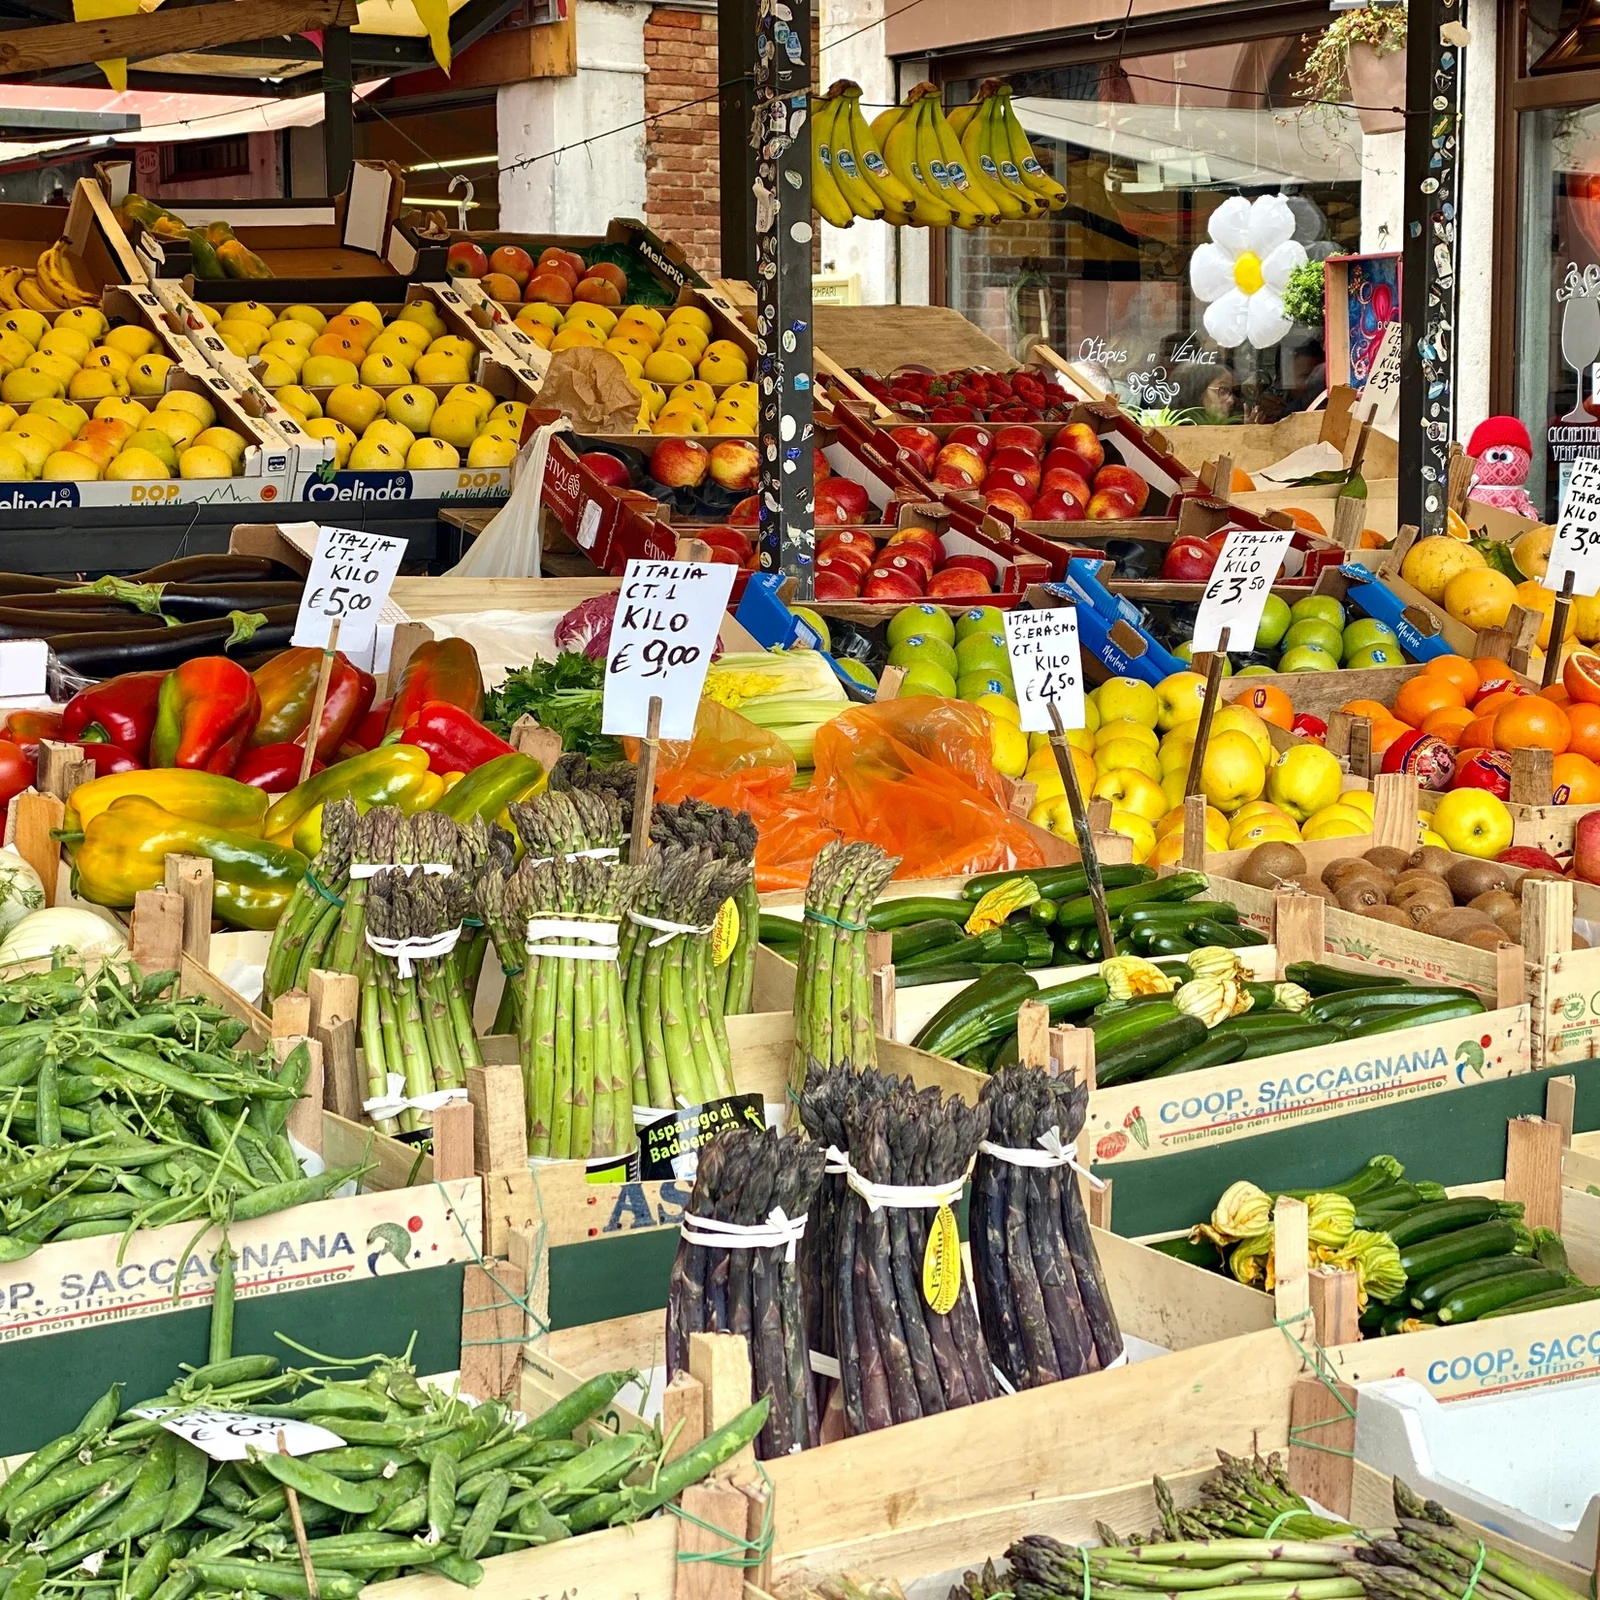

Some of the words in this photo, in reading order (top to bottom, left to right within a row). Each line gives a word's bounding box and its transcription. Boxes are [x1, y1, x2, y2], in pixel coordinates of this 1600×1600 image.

[1564, 504, 1597, 522] KILO
[330, 564, 379, 584] KILO
[1223, 560, 1260, 573] KILO
[621, 605, 689, 633] KILO
[1035, 655, 1070, 672] KILO
[1159, 1088, 1249, 1124] COOP.
[1258, 1047, 1449, 1103] SACCAGNANA
[648, 1110, 718, 1145] Asparago
[720, 1102, 735, 1119] di
[1428, 1348, 1519, 1385] COOP.
[172, 1414, 248, 1427] KILO
